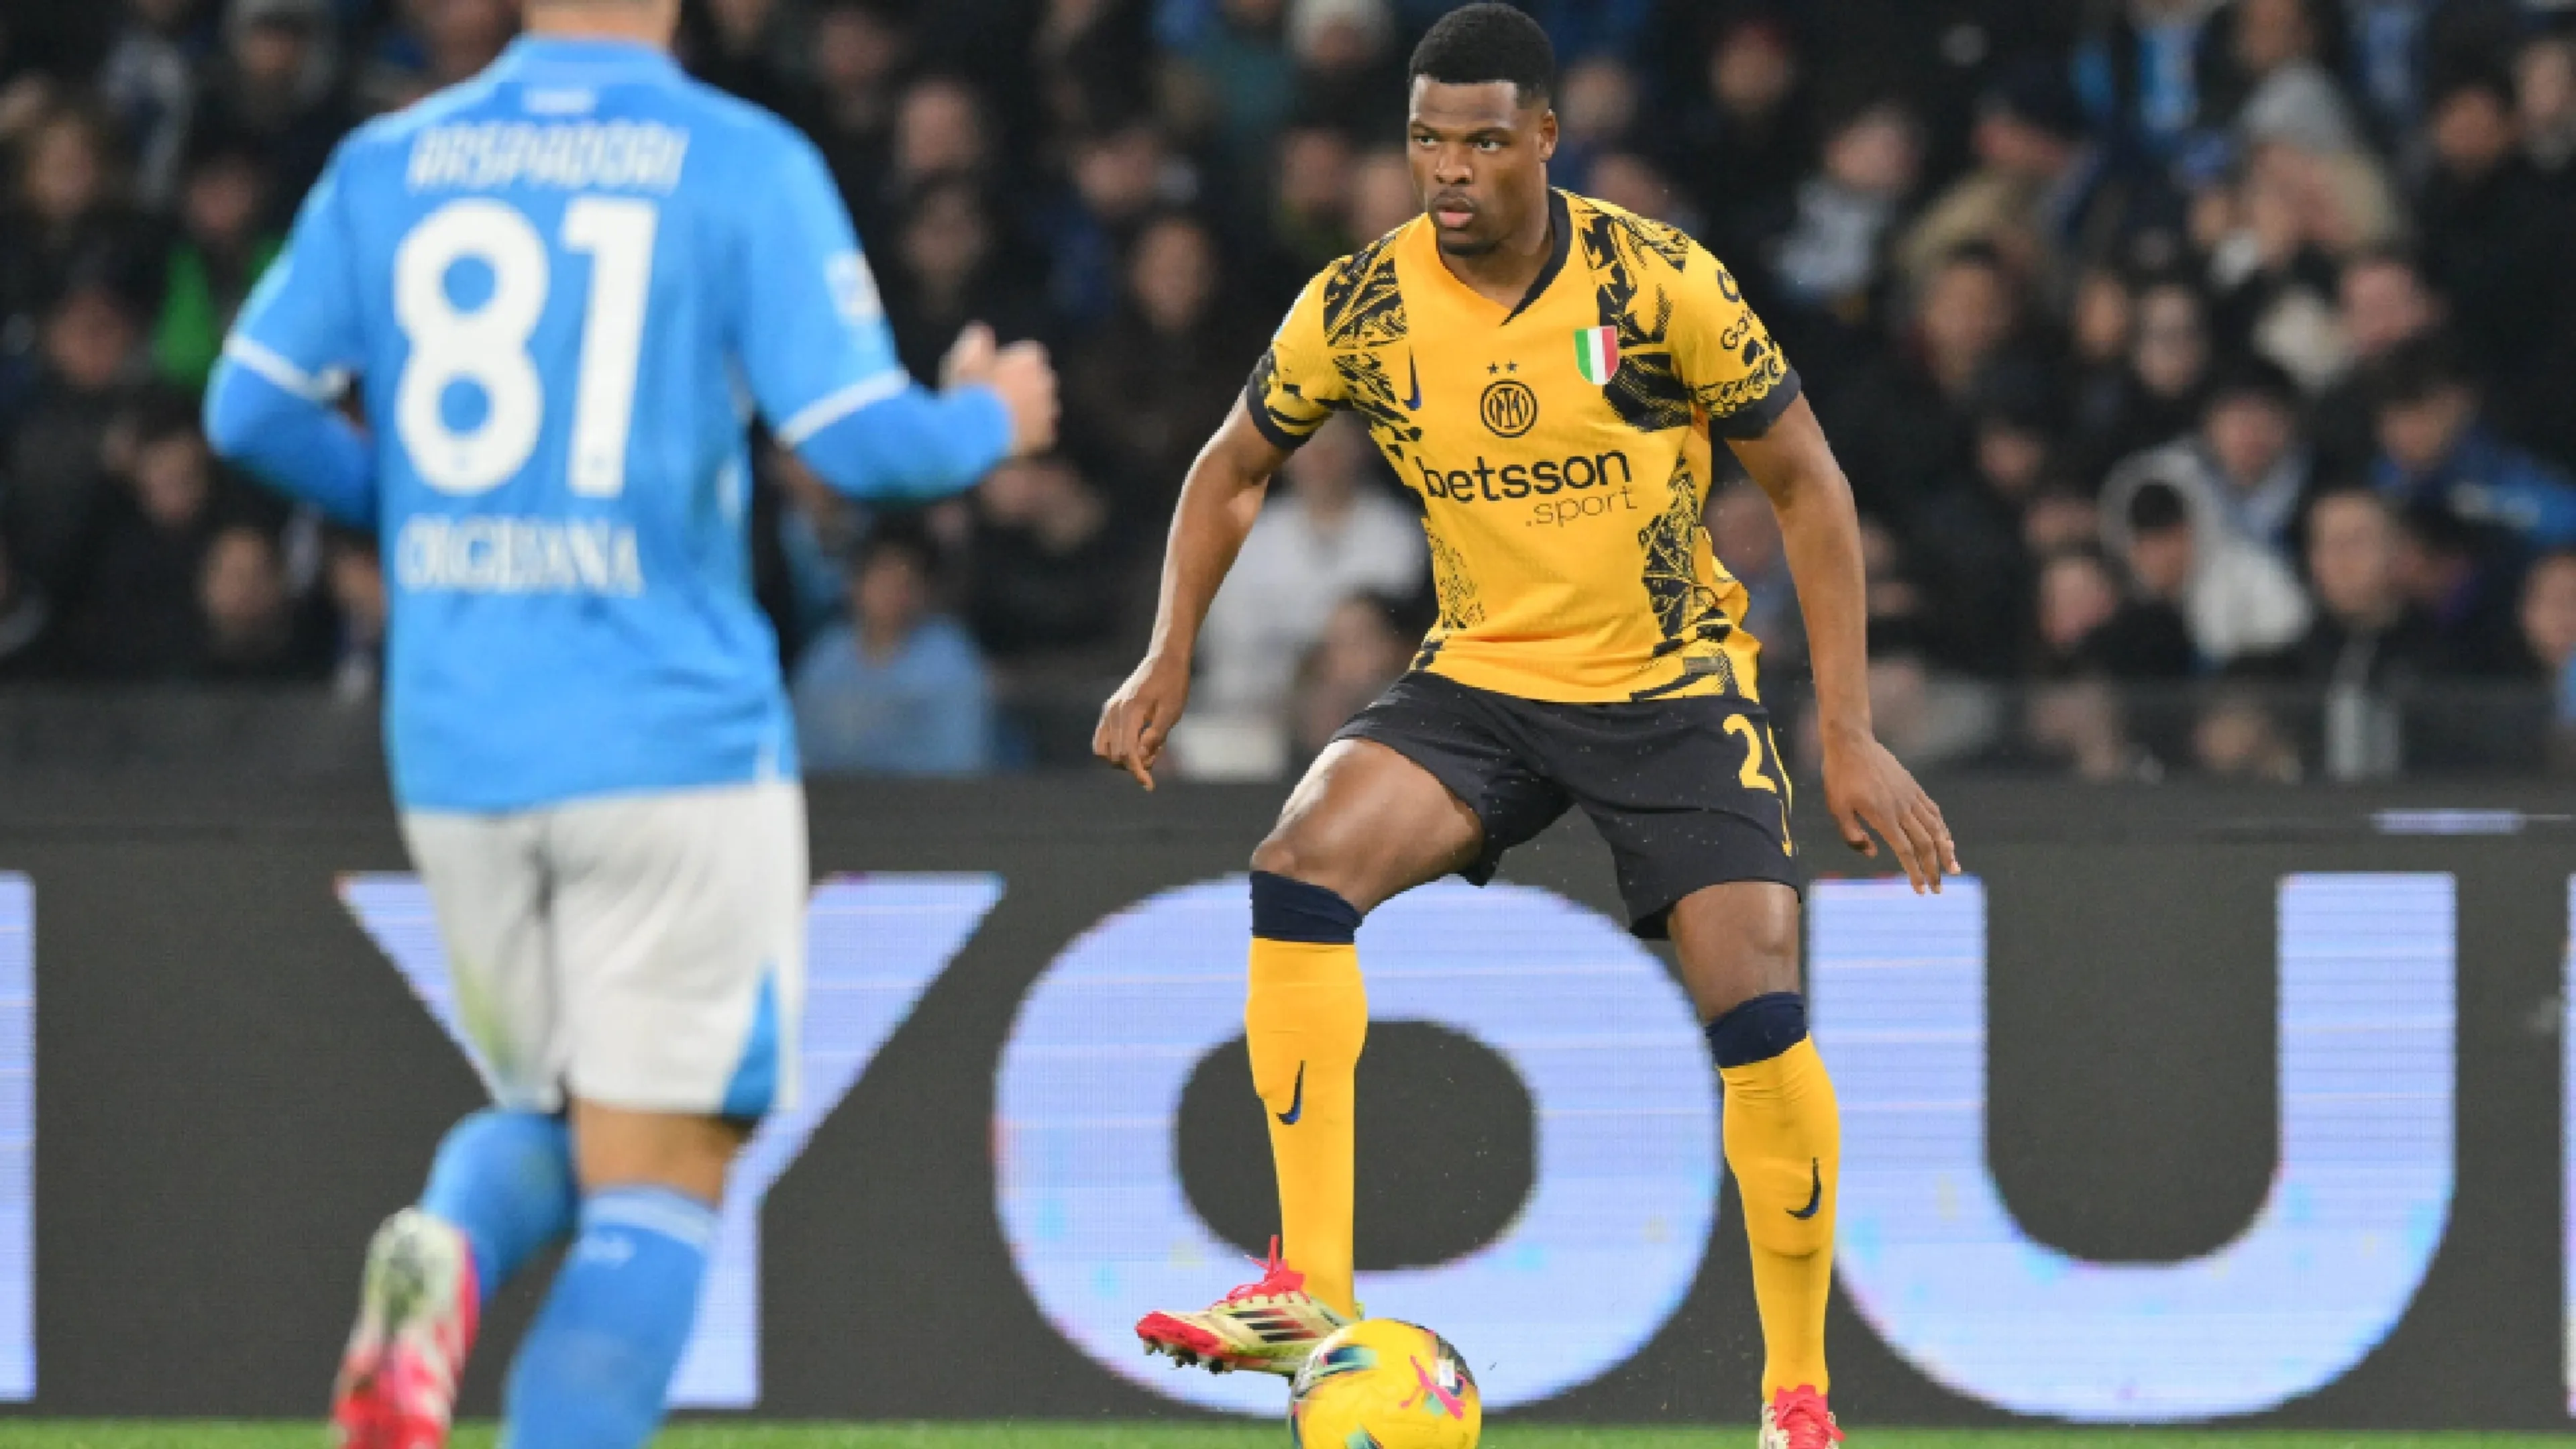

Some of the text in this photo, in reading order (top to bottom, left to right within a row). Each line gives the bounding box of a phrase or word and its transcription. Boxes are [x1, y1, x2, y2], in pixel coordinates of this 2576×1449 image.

[394, 196, 657, 498] 81
[1414, 449, 1632, 503] betsson
[1525, 486, 1638, 527] .sport
